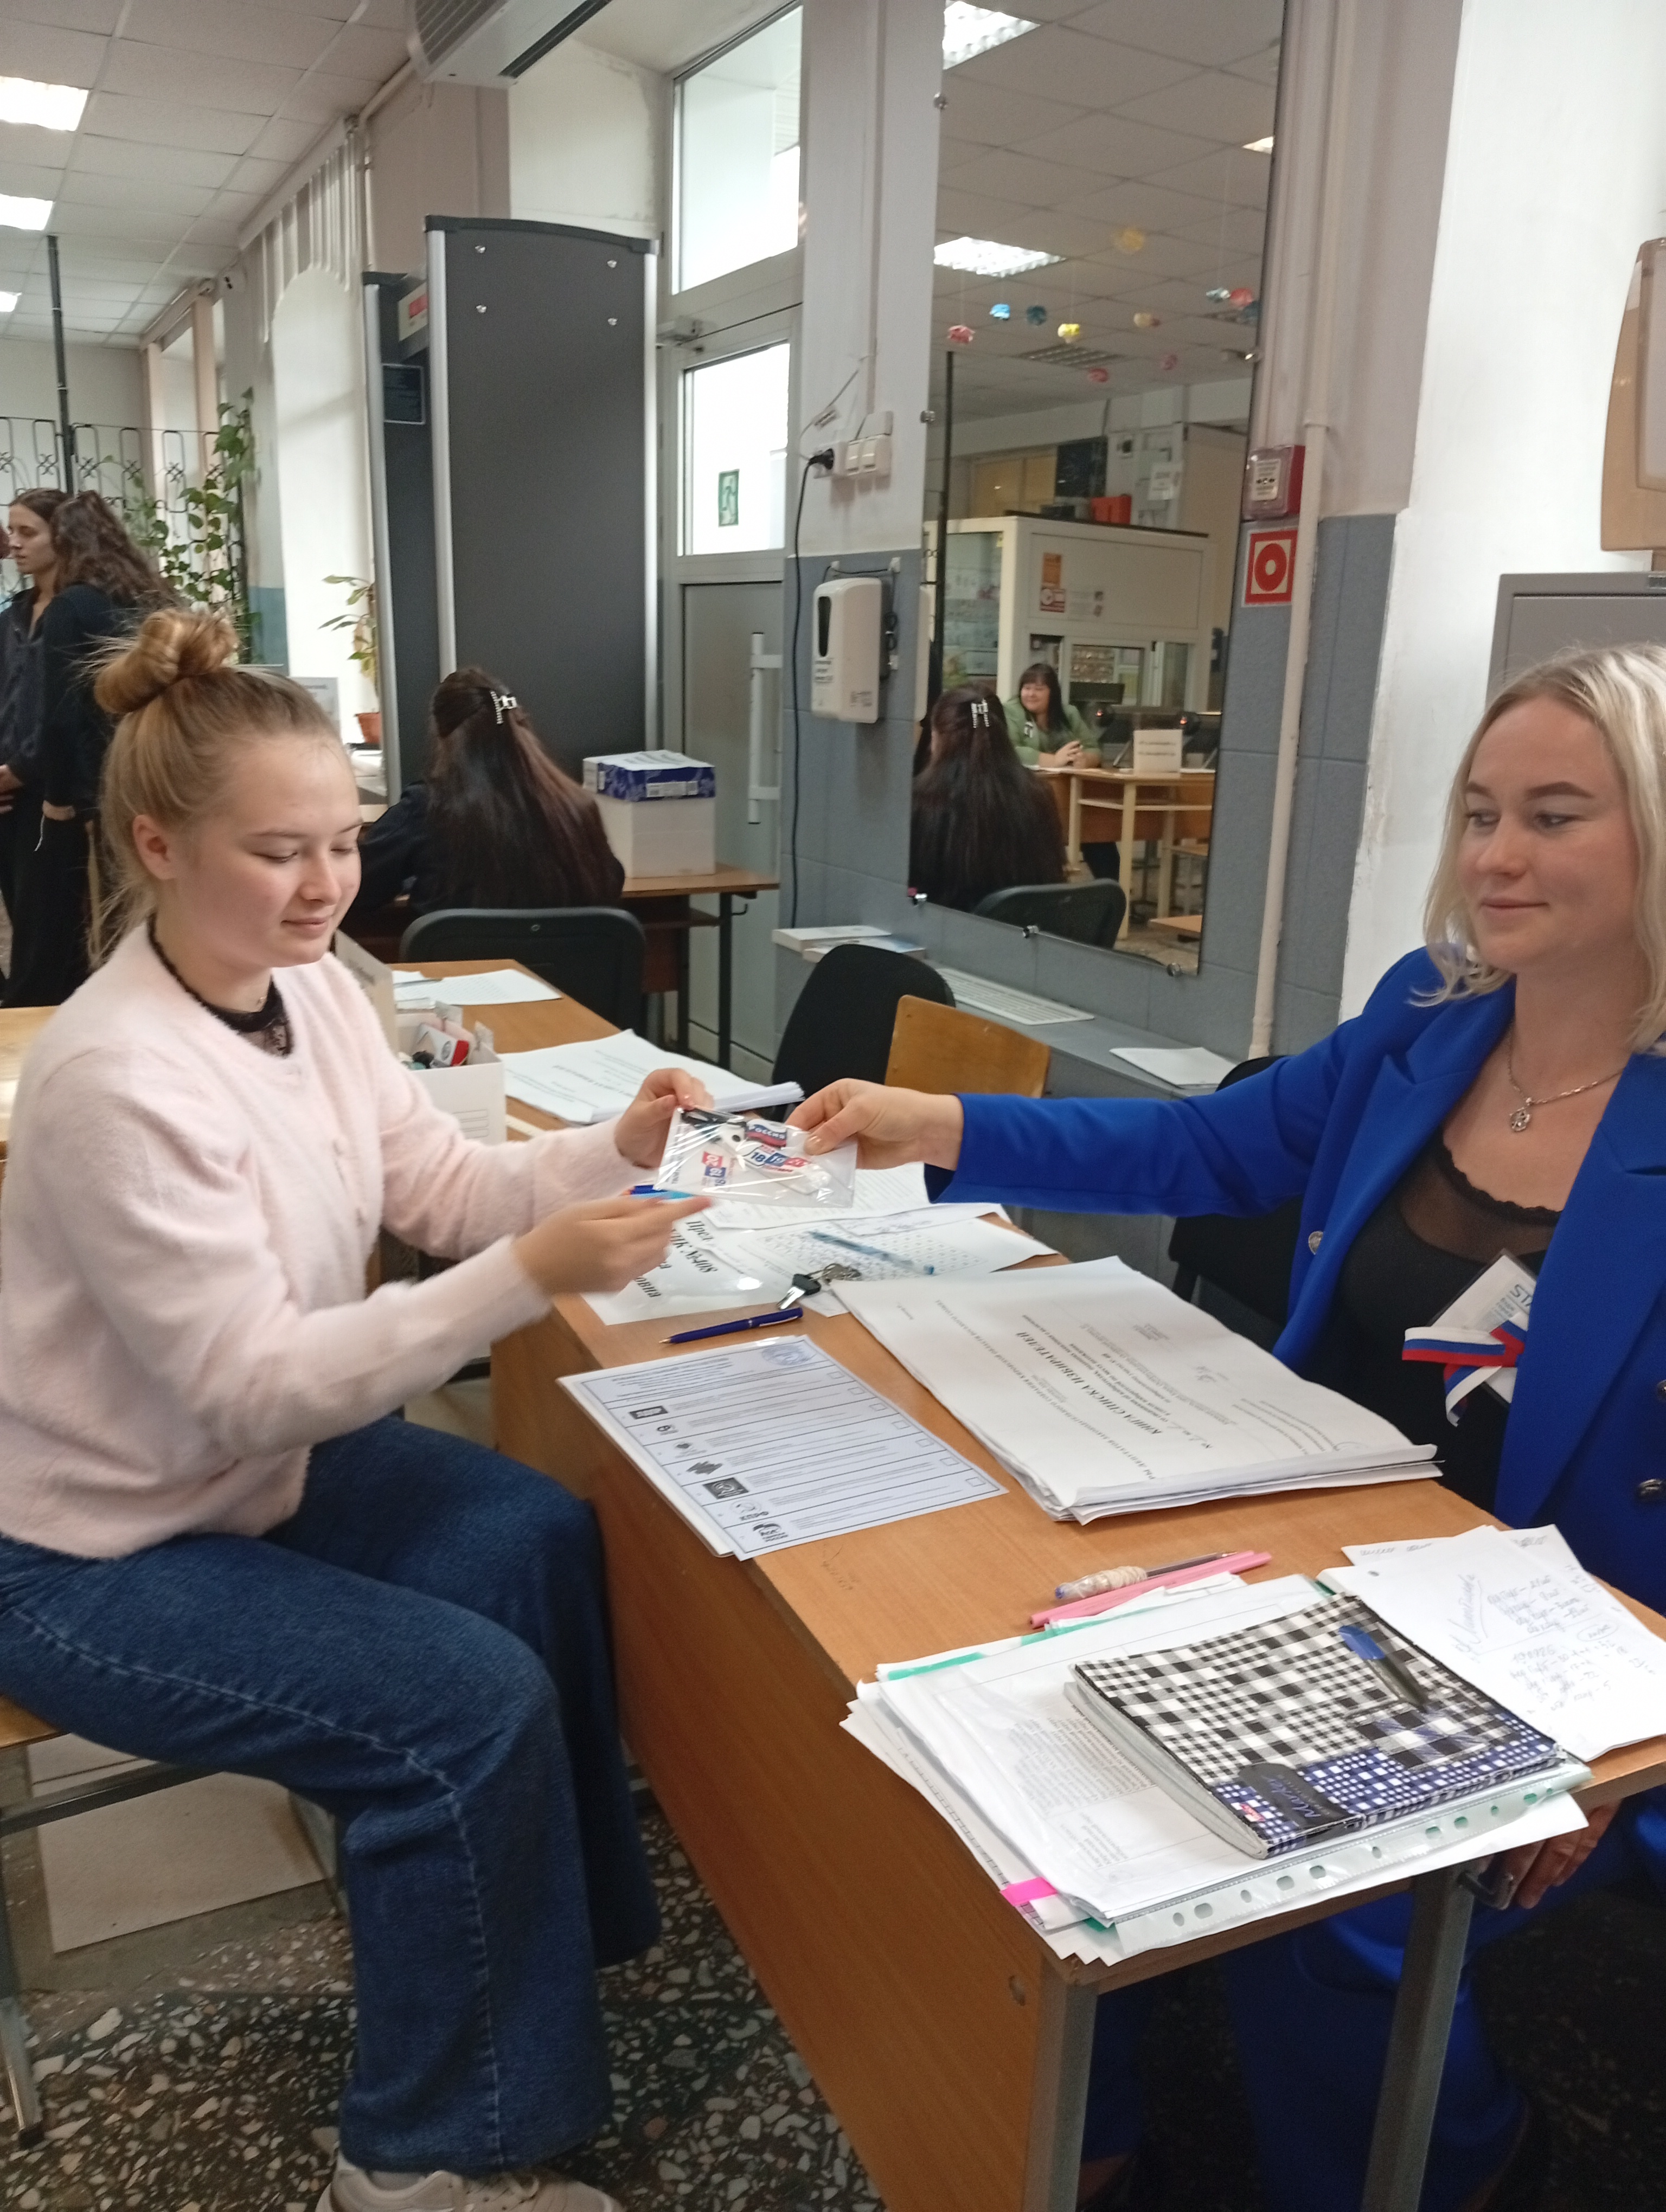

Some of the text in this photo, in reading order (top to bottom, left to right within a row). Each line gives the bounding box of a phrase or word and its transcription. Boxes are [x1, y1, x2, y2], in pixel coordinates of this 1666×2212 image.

[749, 1126, 785, 1139] РОССИЯ
[750, 1152, 766, 1162] 18
[770, 1154, 784, 1163] 19
[710, 1168, 722, 1177] 19
[680, 1246, 718, 1273] №408
[1013, 1332, 1087, 1384] ИЗБИРАТЕЛЕЙ
[1078, 1385, 1128, 1414] СПИСКА
[1119, 1414, 1163, 1434] КНИГА
[739, 1512, 769, 1521] КПРФ
